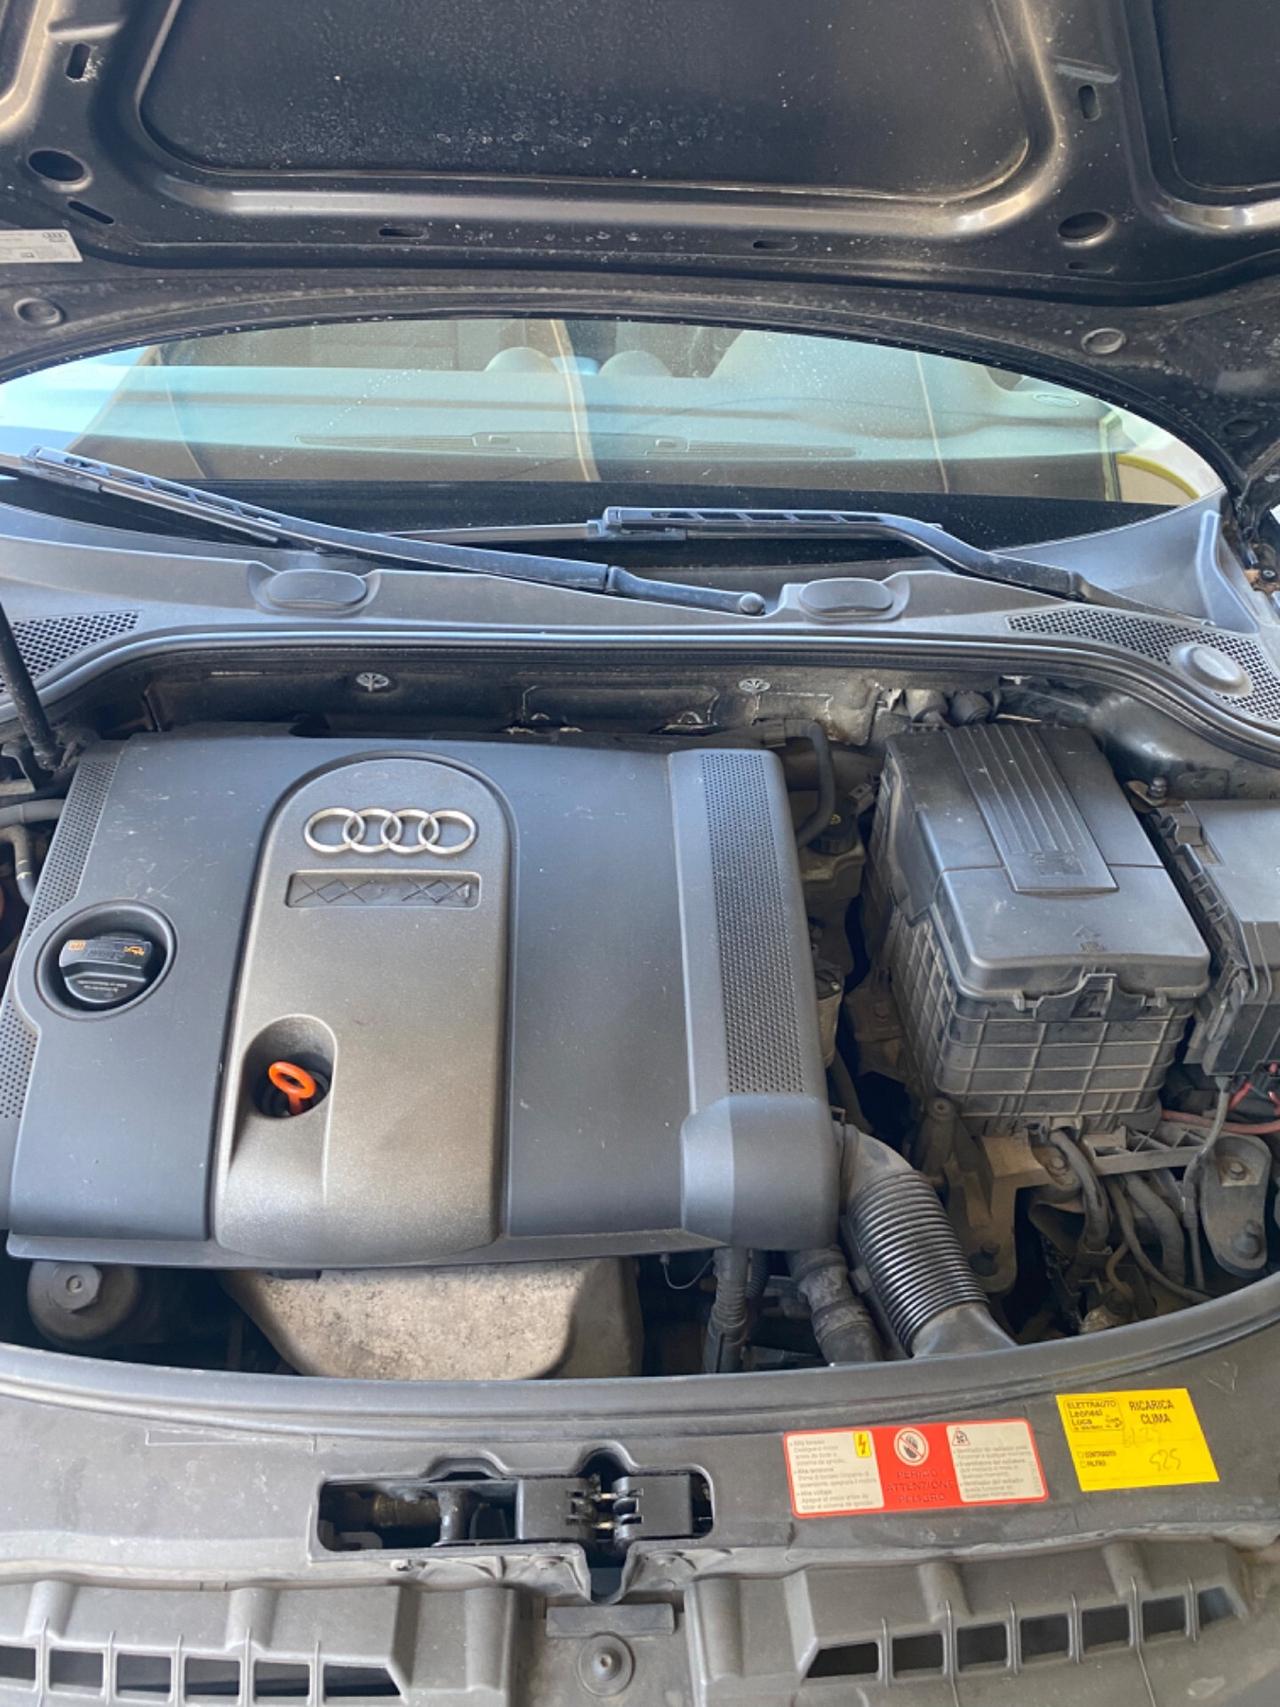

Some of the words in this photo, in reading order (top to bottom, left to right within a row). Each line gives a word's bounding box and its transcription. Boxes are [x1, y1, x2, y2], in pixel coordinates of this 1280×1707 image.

[1128, 1400, 1175, 1411] RICARICA
[1140, 1413, 1172, 1425] CLIMA
[886, 1479, 955, 1492] ATTENZIONE
